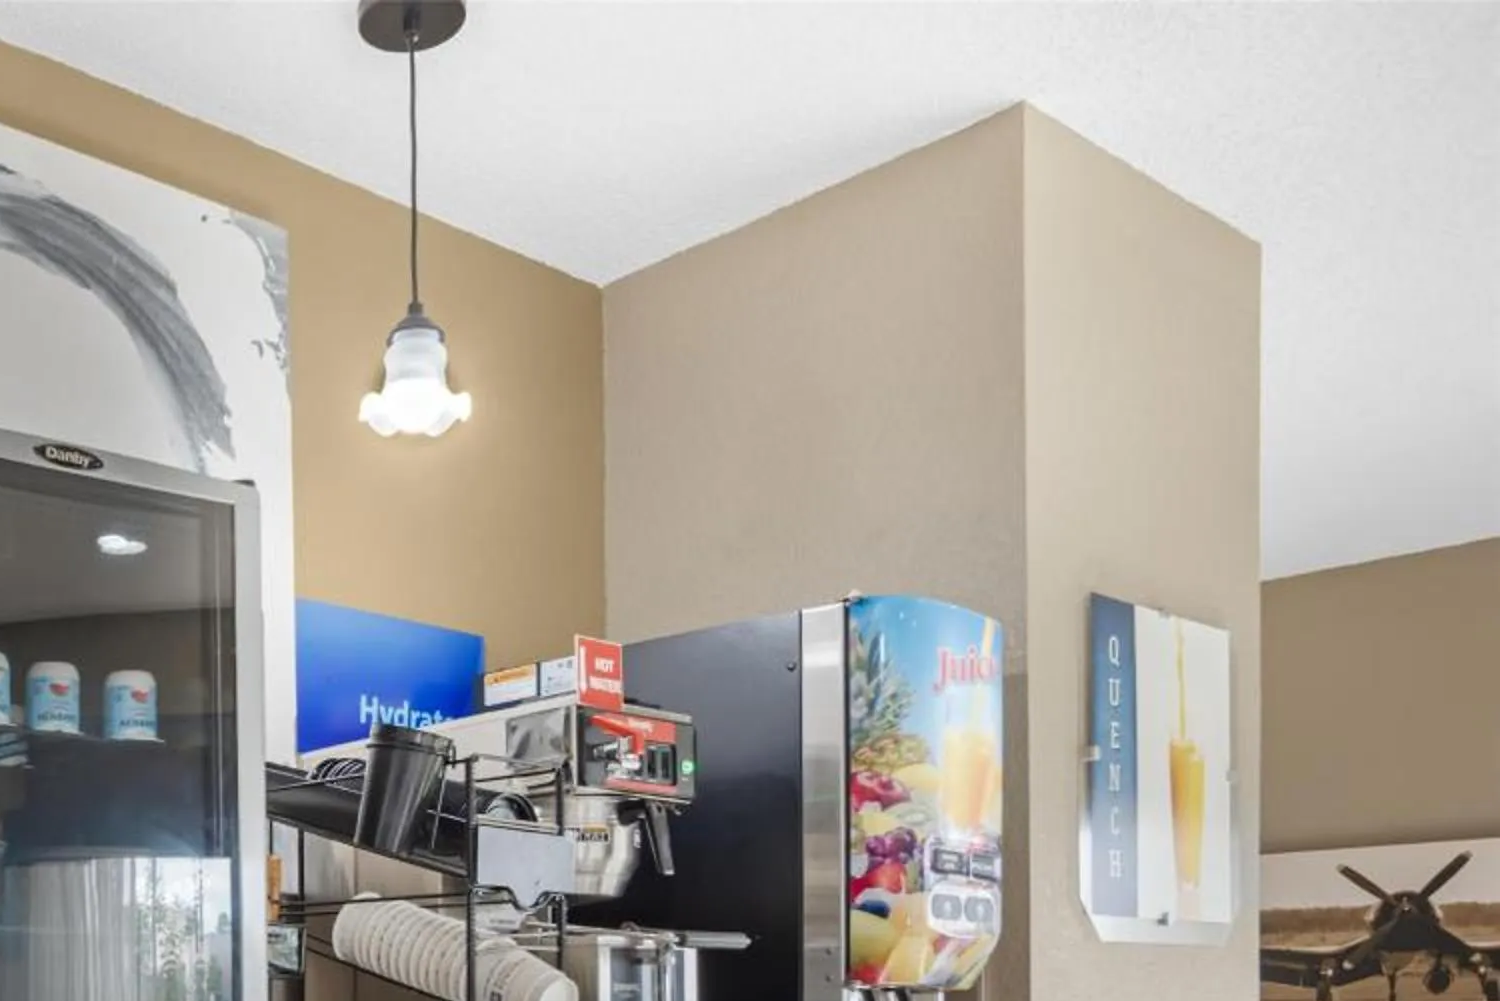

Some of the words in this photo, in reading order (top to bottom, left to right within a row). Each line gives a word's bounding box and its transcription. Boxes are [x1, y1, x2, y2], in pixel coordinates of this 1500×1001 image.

[45, 446, 90, 468] Danby
[359, 693, 455, 729] Hydrat
[1108, 635, 1122, 878] QUENCH
